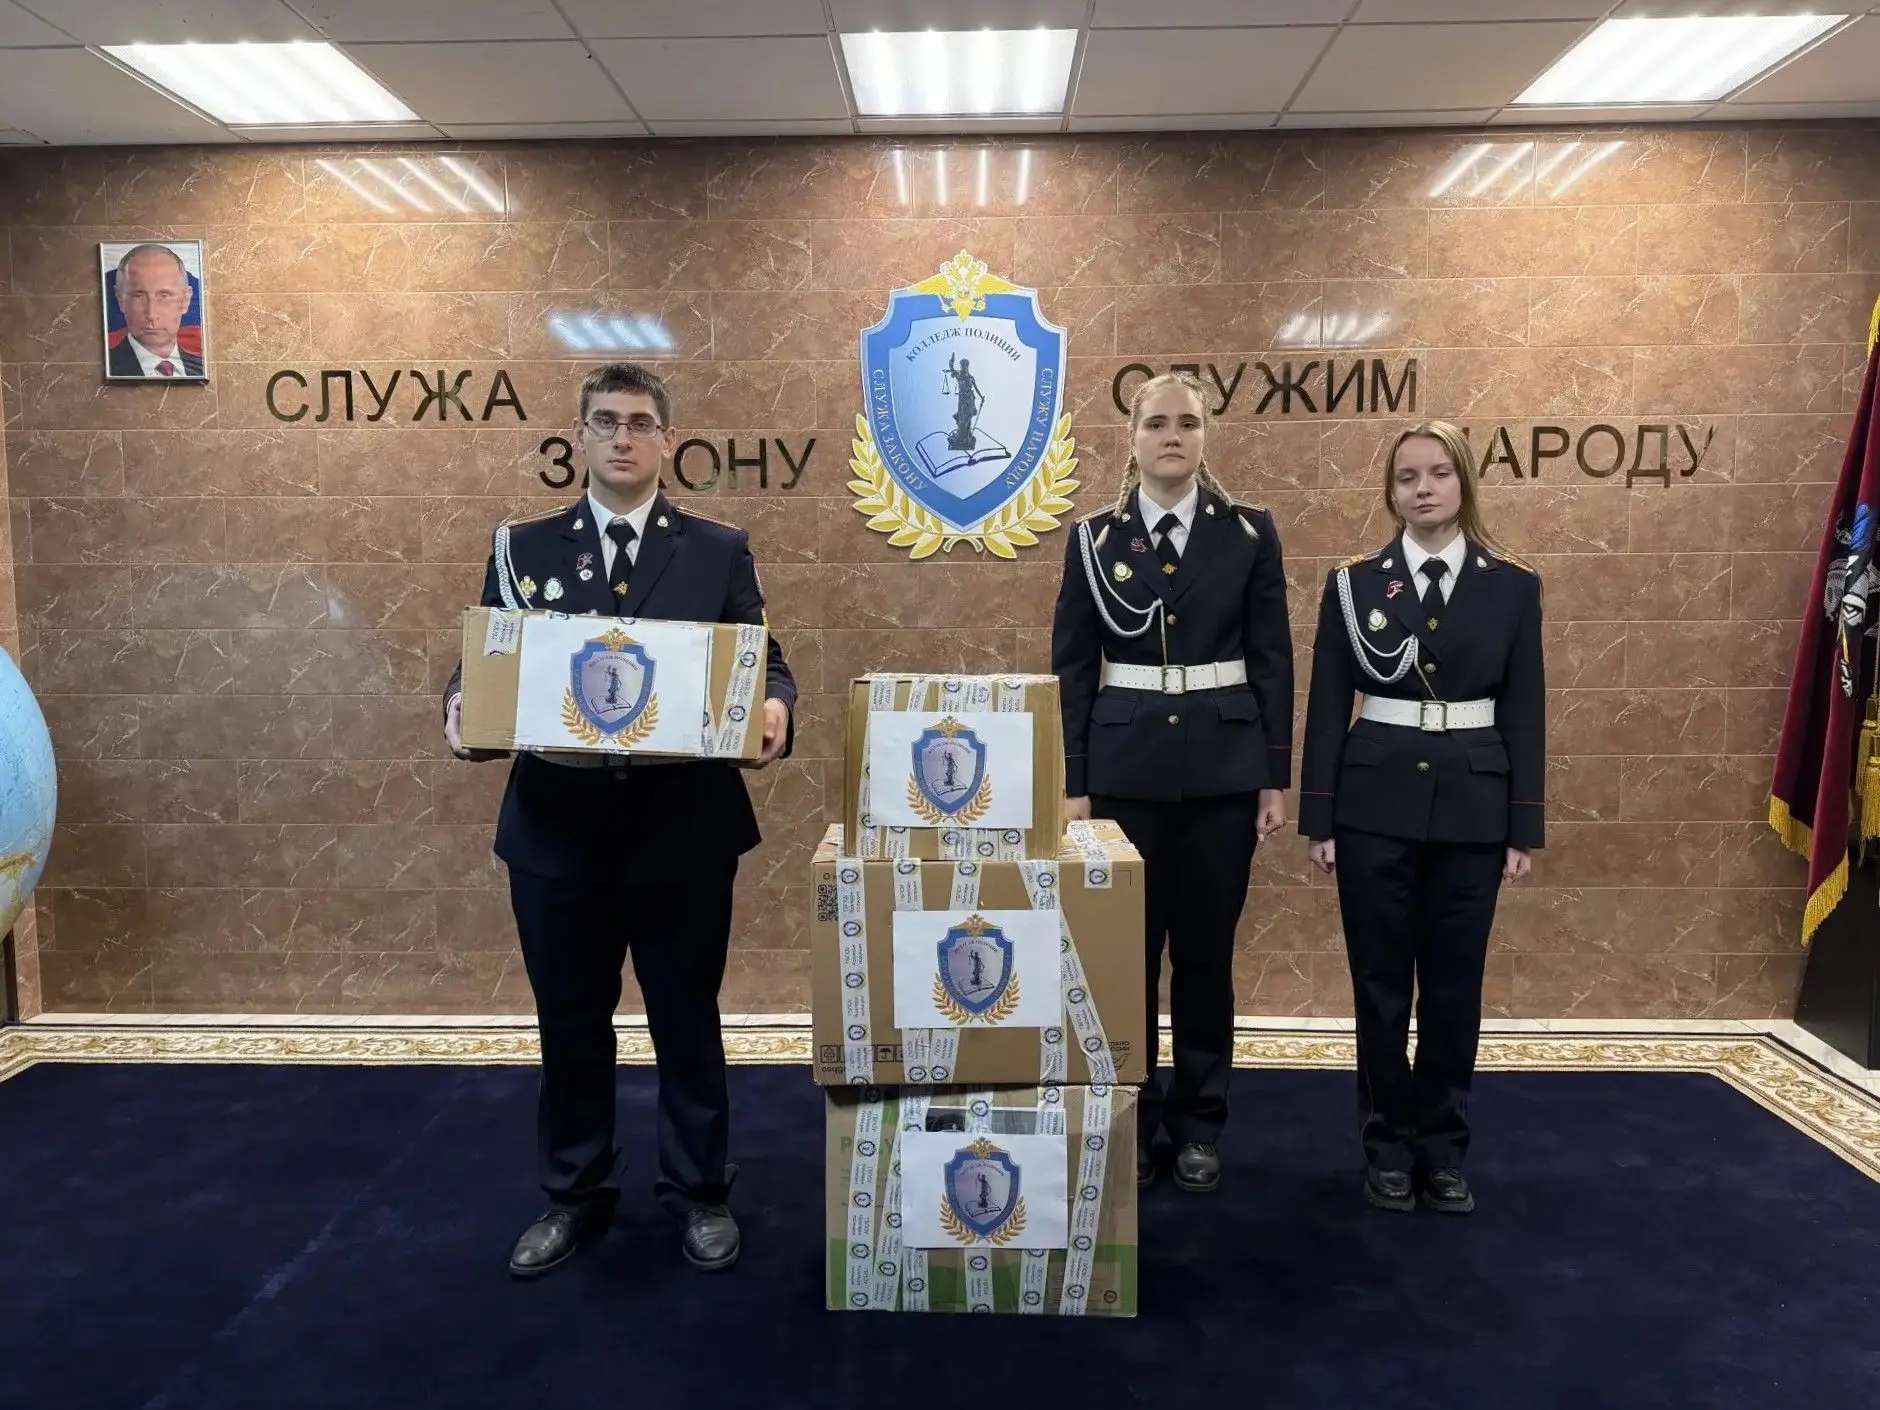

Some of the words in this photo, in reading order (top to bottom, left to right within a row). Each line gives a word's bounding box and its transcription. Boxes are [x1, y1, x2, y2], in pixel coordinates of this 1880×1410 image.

[906, 327, 961, 362] КОЛЛЕДЖ
[965, 327, 1021, 362] ПОЛИЦИИ
[265, 368, 528, 423] СЛУЖА
[1112, 357, 1418, 417] СУЖИМ
[538, 435, 817, 491] ЗОНУ
[882, 433, 928, 491] ЗАКОНУ
[1461, 423, 1720, 490] АРОДУ
